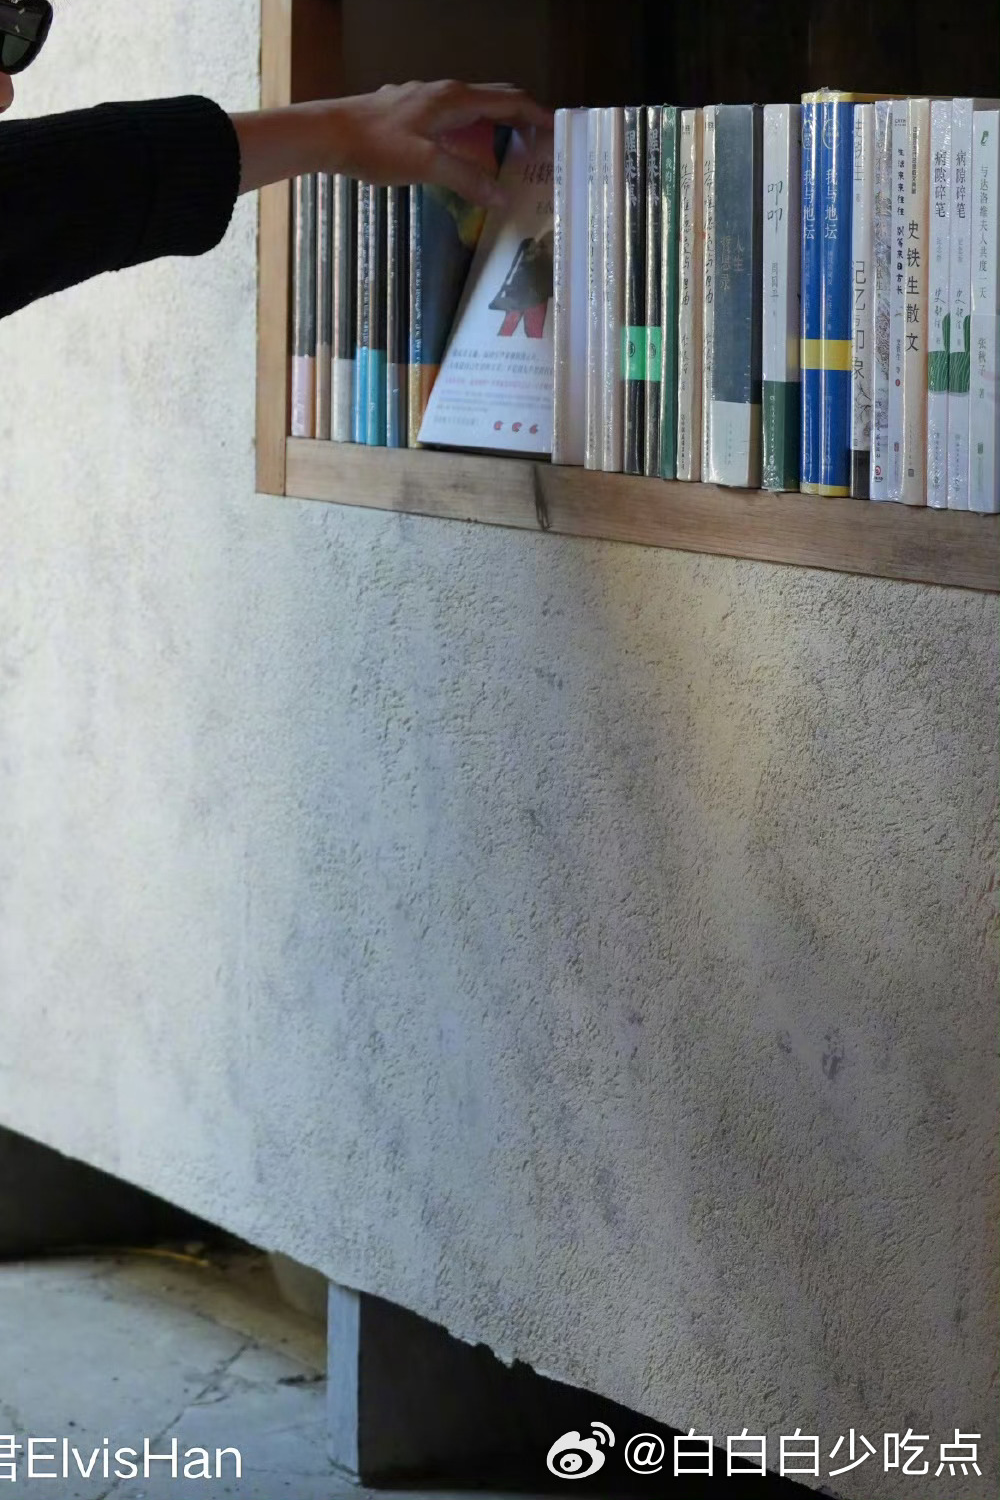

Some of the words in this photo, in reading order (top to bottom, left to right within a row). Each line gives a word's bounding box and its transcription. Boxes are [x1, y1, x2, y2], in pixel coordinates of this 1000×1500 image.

[767, 180, 783, 234] 叩叩
[804, 168, 816, 240] 我与地坛
[825, 168, 838, 240] 我与地坛
[897, 148, 905, 217] 生活来来往往
[934, 151, 946, 218] 病隙碎笔
[955, 150, 966, 219] 病隙碎笔
[896, 225, 904, 295] 别等来日方长
[979, 166, 989, 299] 与达洛维夫人共度一天
[906, 219, 921, 352] 史铁生散文
[978, 337, 986, 377] 张秋子
